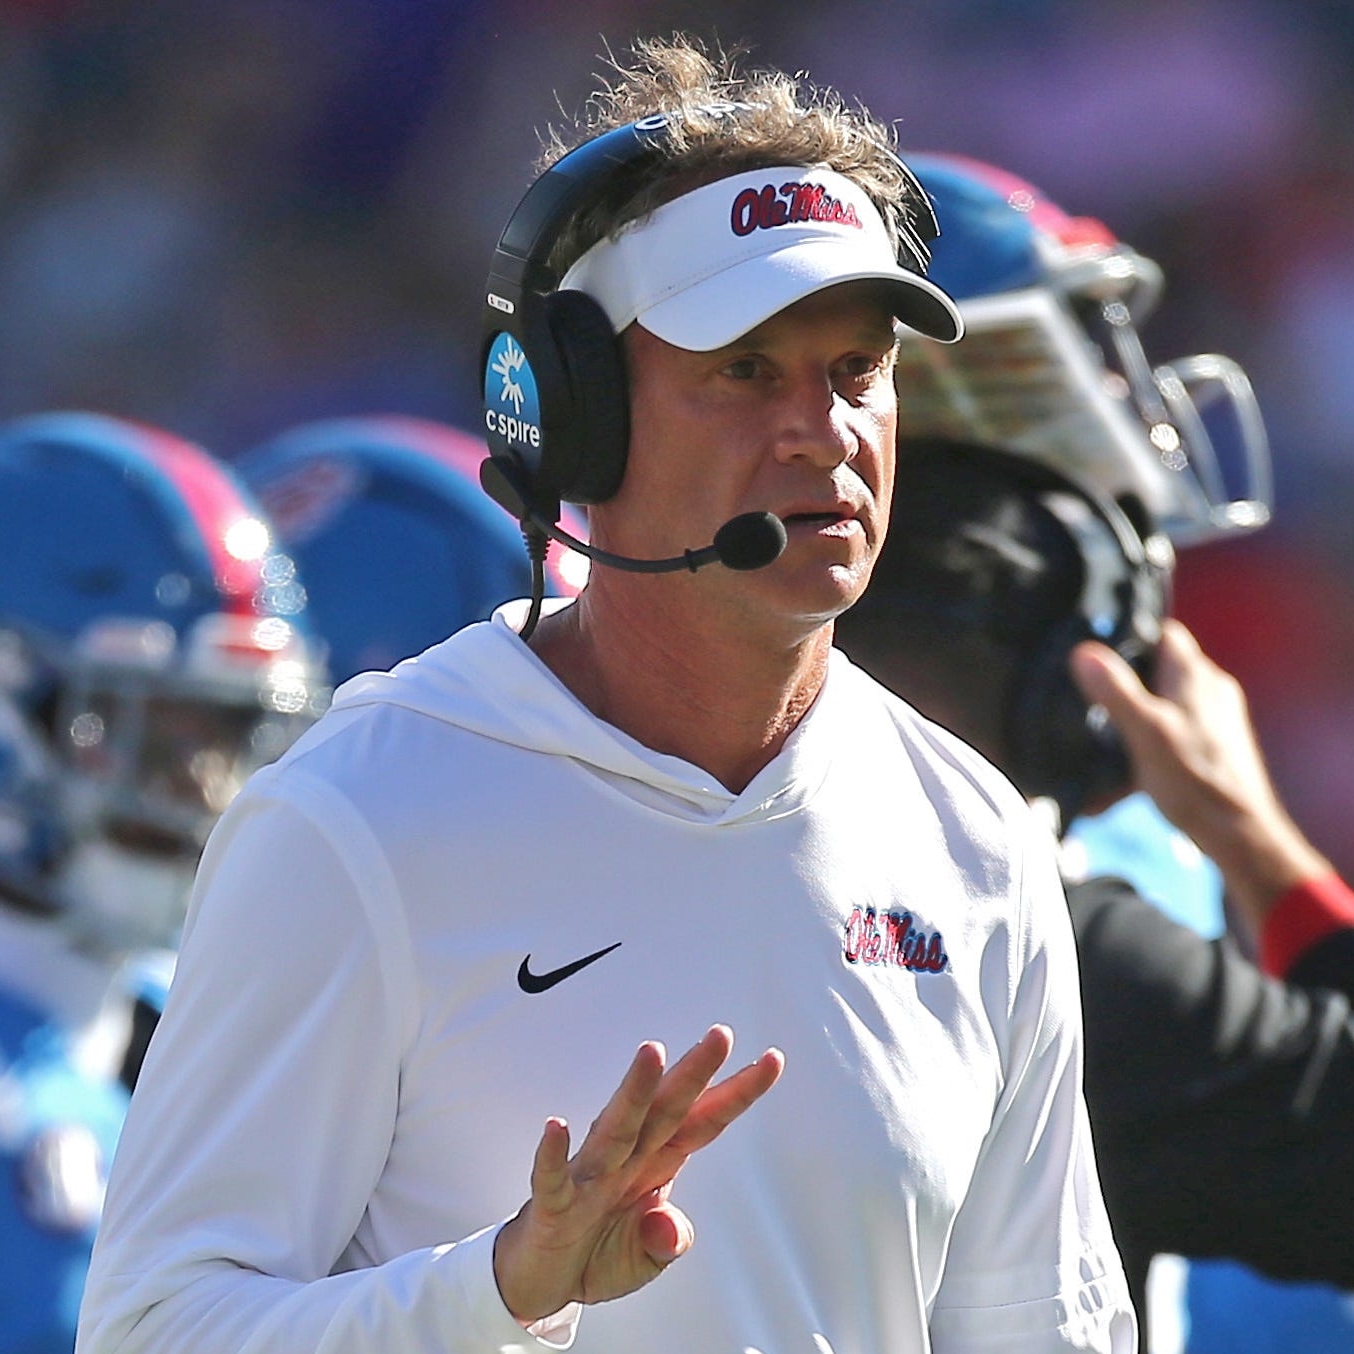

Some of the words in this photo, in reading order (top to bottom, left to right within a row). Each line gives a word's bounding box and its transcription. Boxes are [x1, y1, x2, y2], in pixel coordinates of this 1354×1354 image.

[731, 184, 788, 237] Ole
[779, 182, 863, 230] Miss
[879, 909, 947, 974] Miss
